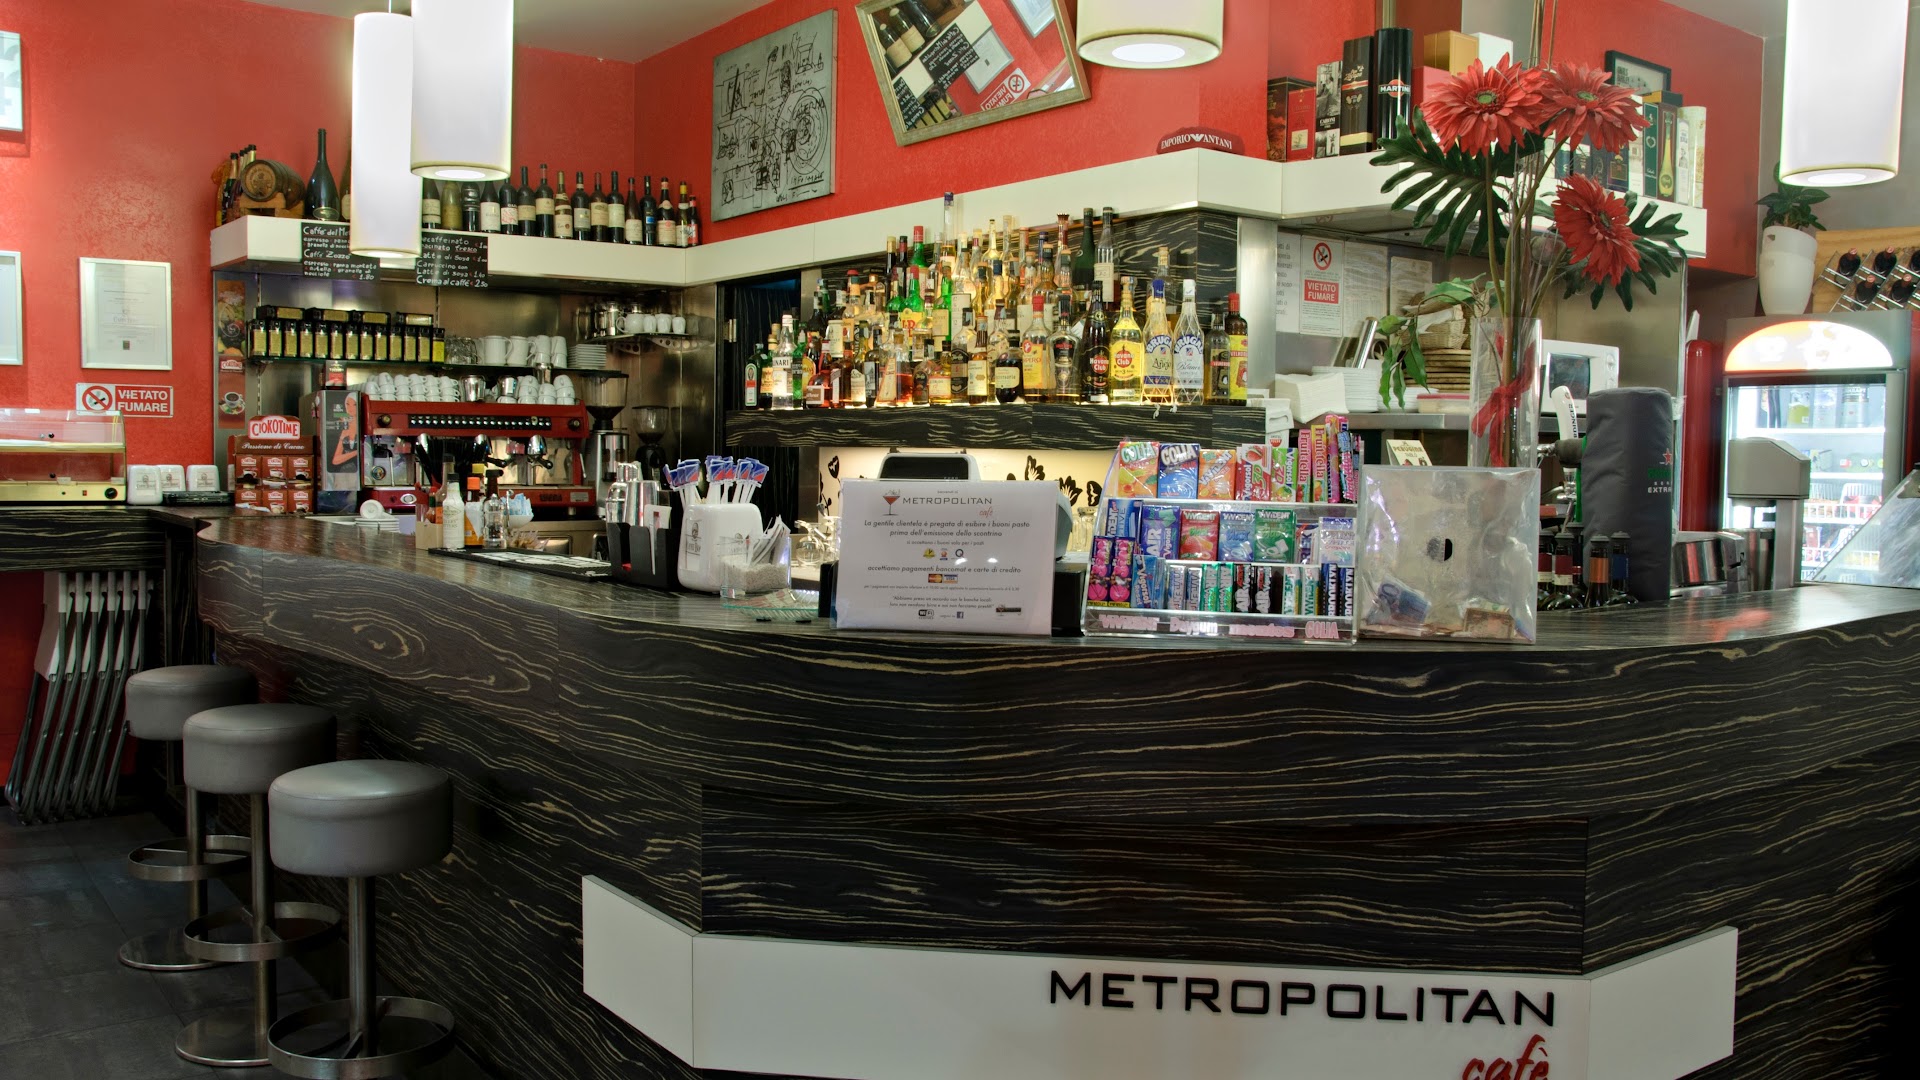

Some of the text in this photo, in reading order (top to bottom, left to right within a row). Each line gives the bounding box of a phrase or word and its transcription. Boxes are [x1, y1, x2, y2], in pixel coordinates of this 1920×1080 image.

[1161, 134, 1233, 149] EMPORIO ANTANI
[422, 236, 469, 245] ecaffeinato
[1307, 282, 1336, 292] VIETATO
[1308, 291, 1335, 301] FUMARE
[118, 389, 168, 401] VIETATO
[117, 401, 168, 413] FUMARE
[251, 419, 298, 436] CIOKOTIME
[241, 442, 305, 450] Passione di Cacao
[1161, 444, 1197, 466] GOLIA
[1285, 450, 1294, 485] Vigorsol
[902, 497, 993, 505] METROPOLITAN
[873, 520, 894, 528] gentile
[929, 520, 955, 528] pregata
[889, 529, 908, 537] prima
[1146, 528, 1162, 556] AIR
[1163, 528, 1172, 559] Vigorsol
[901, 565, 933, 573] pagamenti
[935, 565, 967, 573] bancomat
[1137, 567, 1152, 603] Vigorsol
[1235, 589, 1250, 611] AIR
[1255, 590, 1270, 612] AIR
[1305, 621, 1339, 639] GOLIA
[1050, 970, 1554, 1027] METROPOLITAN
